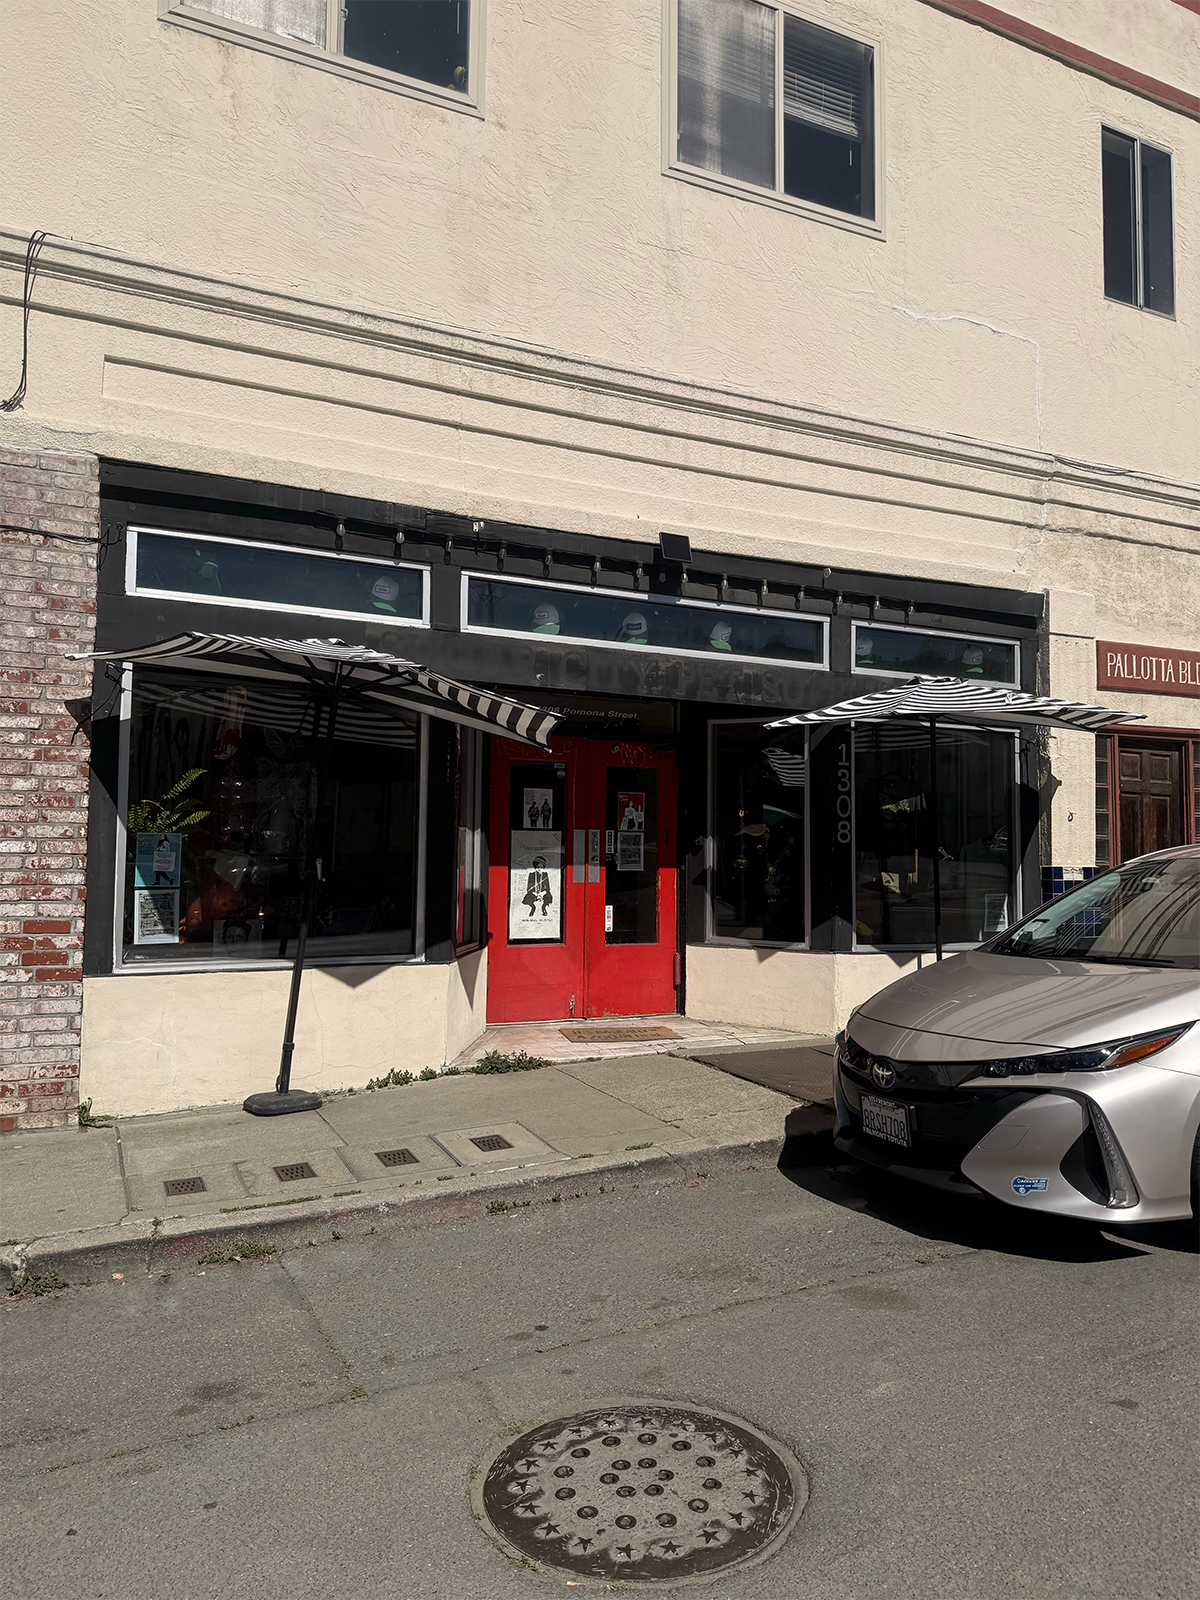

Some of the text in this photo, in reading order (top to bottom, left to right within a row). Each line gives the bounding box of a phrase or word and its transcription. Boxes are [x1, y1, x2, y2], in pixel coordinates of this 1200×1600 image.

[1107, 652, 1176, 683] PALLOTTA
[562, 707, 605, 717] Pomona
[607, 710, 638, 719] Street
[836, 743, 851, 844] 1308
[864, 1108, 906, 1140] 8RSH708
